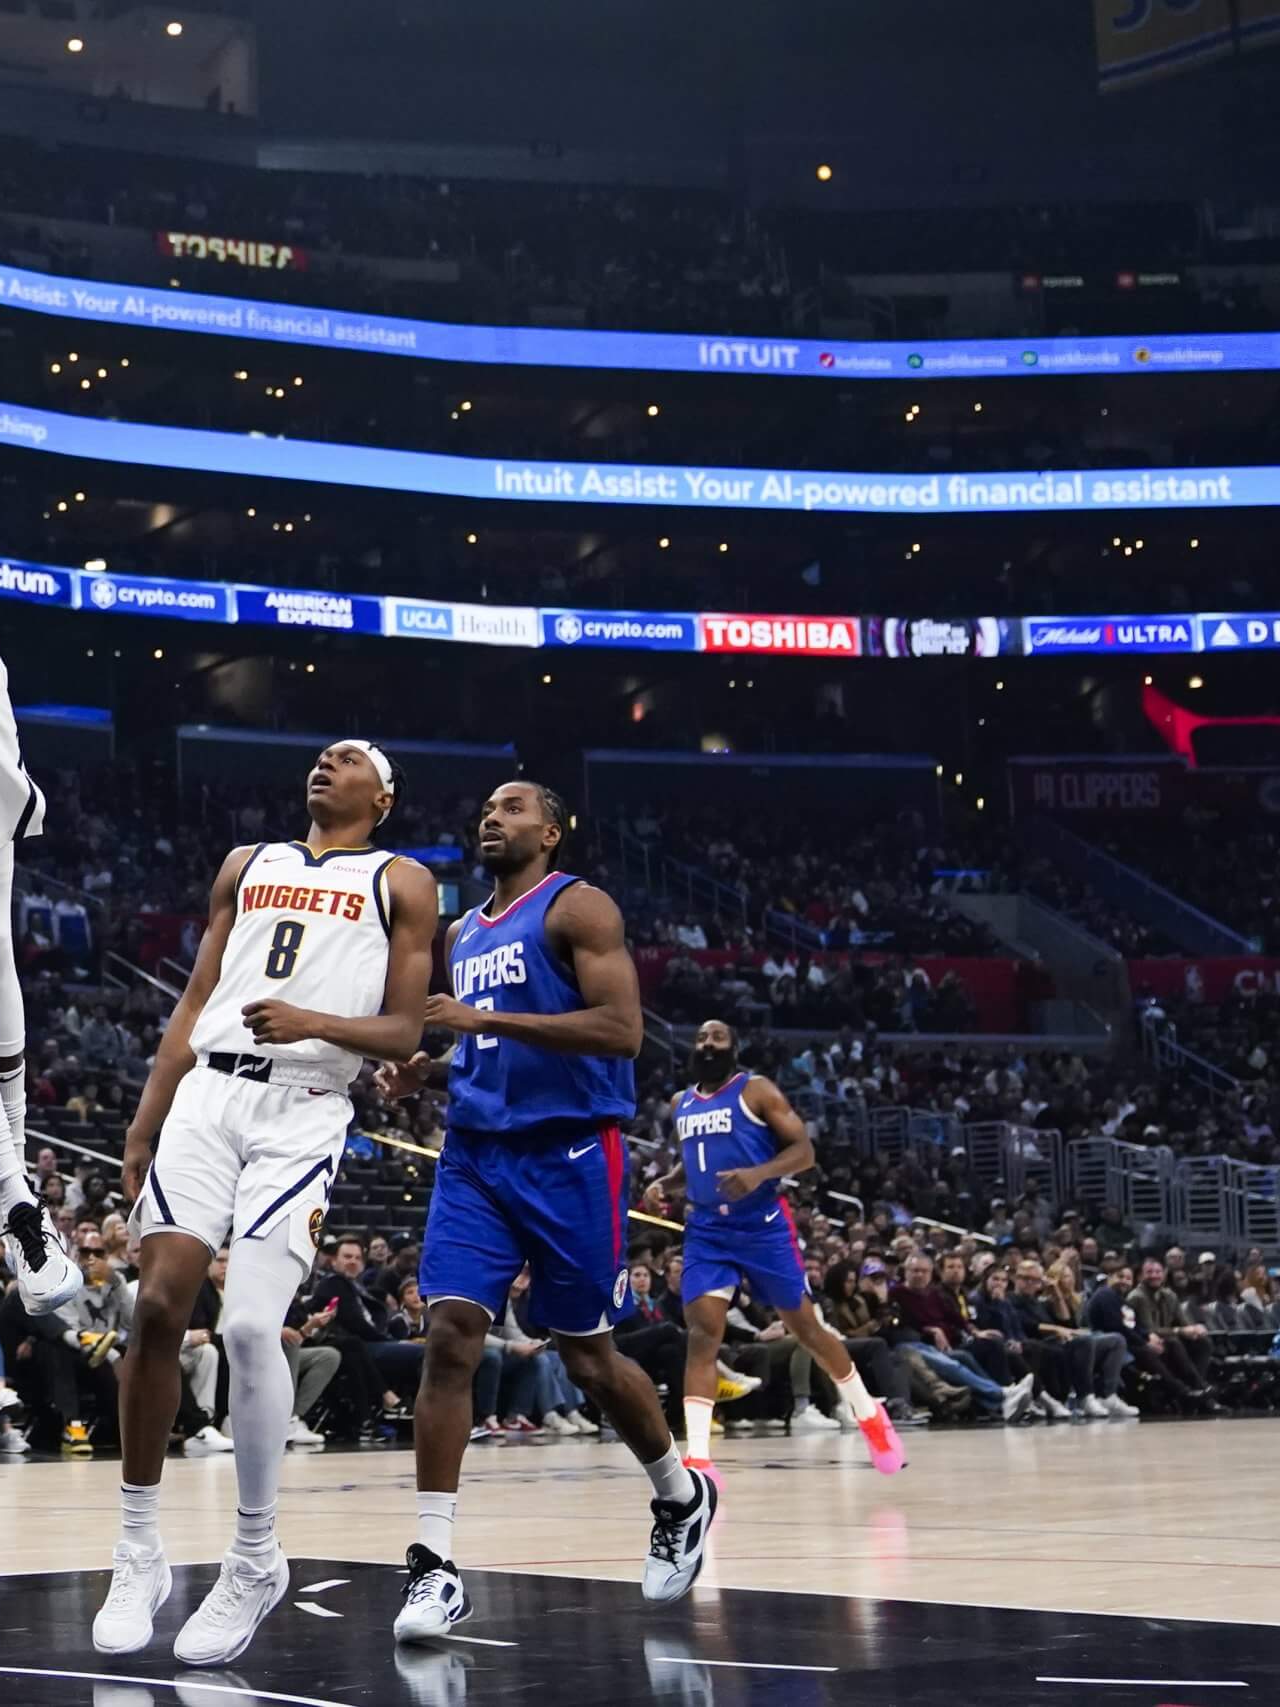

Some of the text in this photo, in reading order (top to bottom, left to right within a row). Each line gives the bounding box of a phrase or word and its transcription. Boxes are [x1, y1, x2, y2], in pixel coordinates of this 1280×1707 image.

[8, 279, 68, 308] Assist:
[73, 290, 118, 314] Your
[124, 296, 241, 329] AI-powered
[247, 308, 329, 338] financial
[335, 323, 417, 348] assistant
[699, 342, 800, 369] INTUIT
[495, 465, 1231, 510] Intuit Assist: Your AI-powered financial assistant
[119, 587, 215, 609] crypto.com
[265, 592, 353, 613] AMERICAN
[277, 609, 354, 628] EXPRESS
[402, 608, 527, 637] UCLA Health
[584, 620, 682, 640] crypto.com
[1118, 623, 1189, 643] ULTRA
[706, 620, 852, 649] TOSHIBA
[1061, 771, 1161, 808] CLIPPERS
[242, 884, 366, 922] NUGGETS
[264, 919, 305, 979] 8
[453, 941, 527, 1000] CLIPPERS
[677, 1107, 732, 1141] CLIPPERS
[698, 1142, 706, 1172] 1
